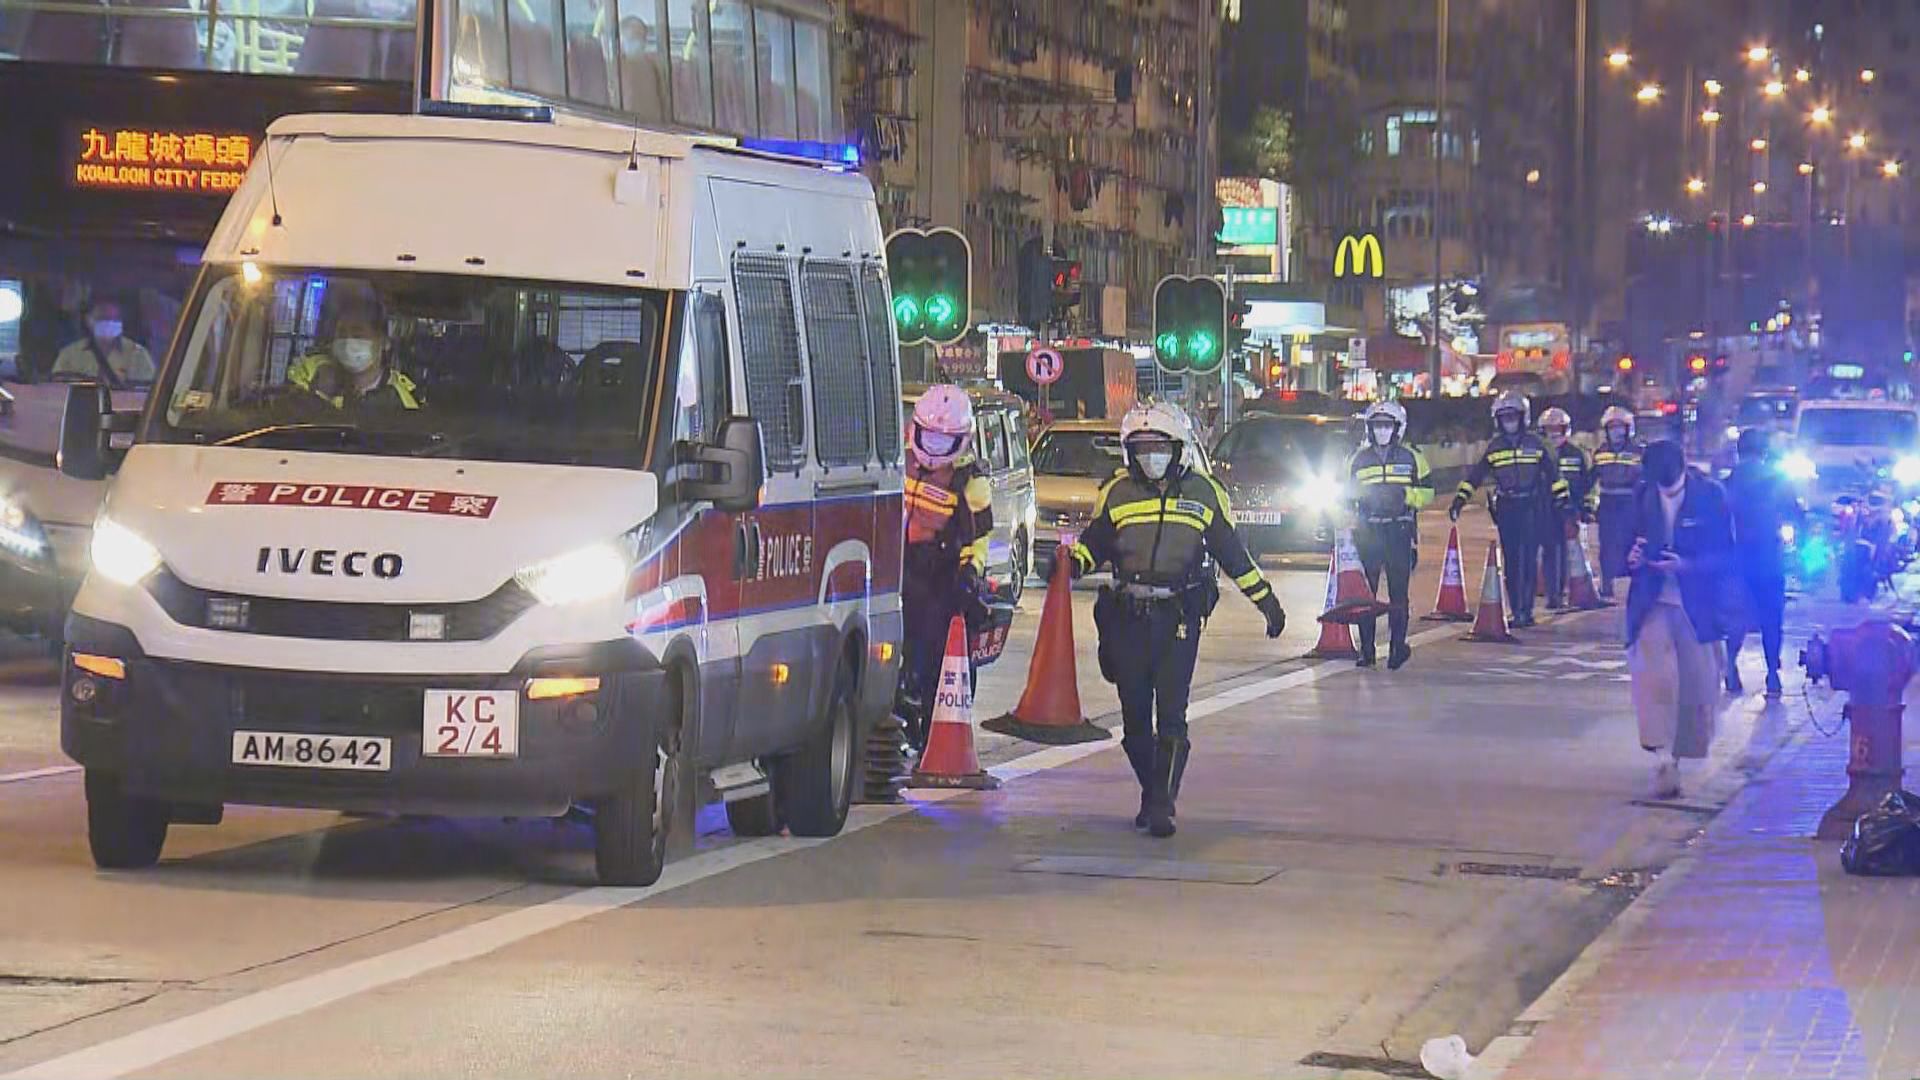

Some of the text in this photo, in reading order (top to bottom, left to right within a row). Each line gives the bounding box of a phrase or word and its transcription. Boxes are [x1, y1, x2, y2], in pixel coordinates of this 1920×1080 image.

[81, 128, 250, 167] 九龍城碼頭
[76, 164, 149, 185] KOWLOON
[154, 168, 198, 187] CITY
[219, 484, 488, 515] 警 POLICE 察
[256, 546, 404, 579] IVECO
[766, 533, 802, 579] POLICE
[937, 691, 972, 709] POLIC
[242, 736, 382, 766] AM 8642
[437, 726, 503, 754] 2/4
